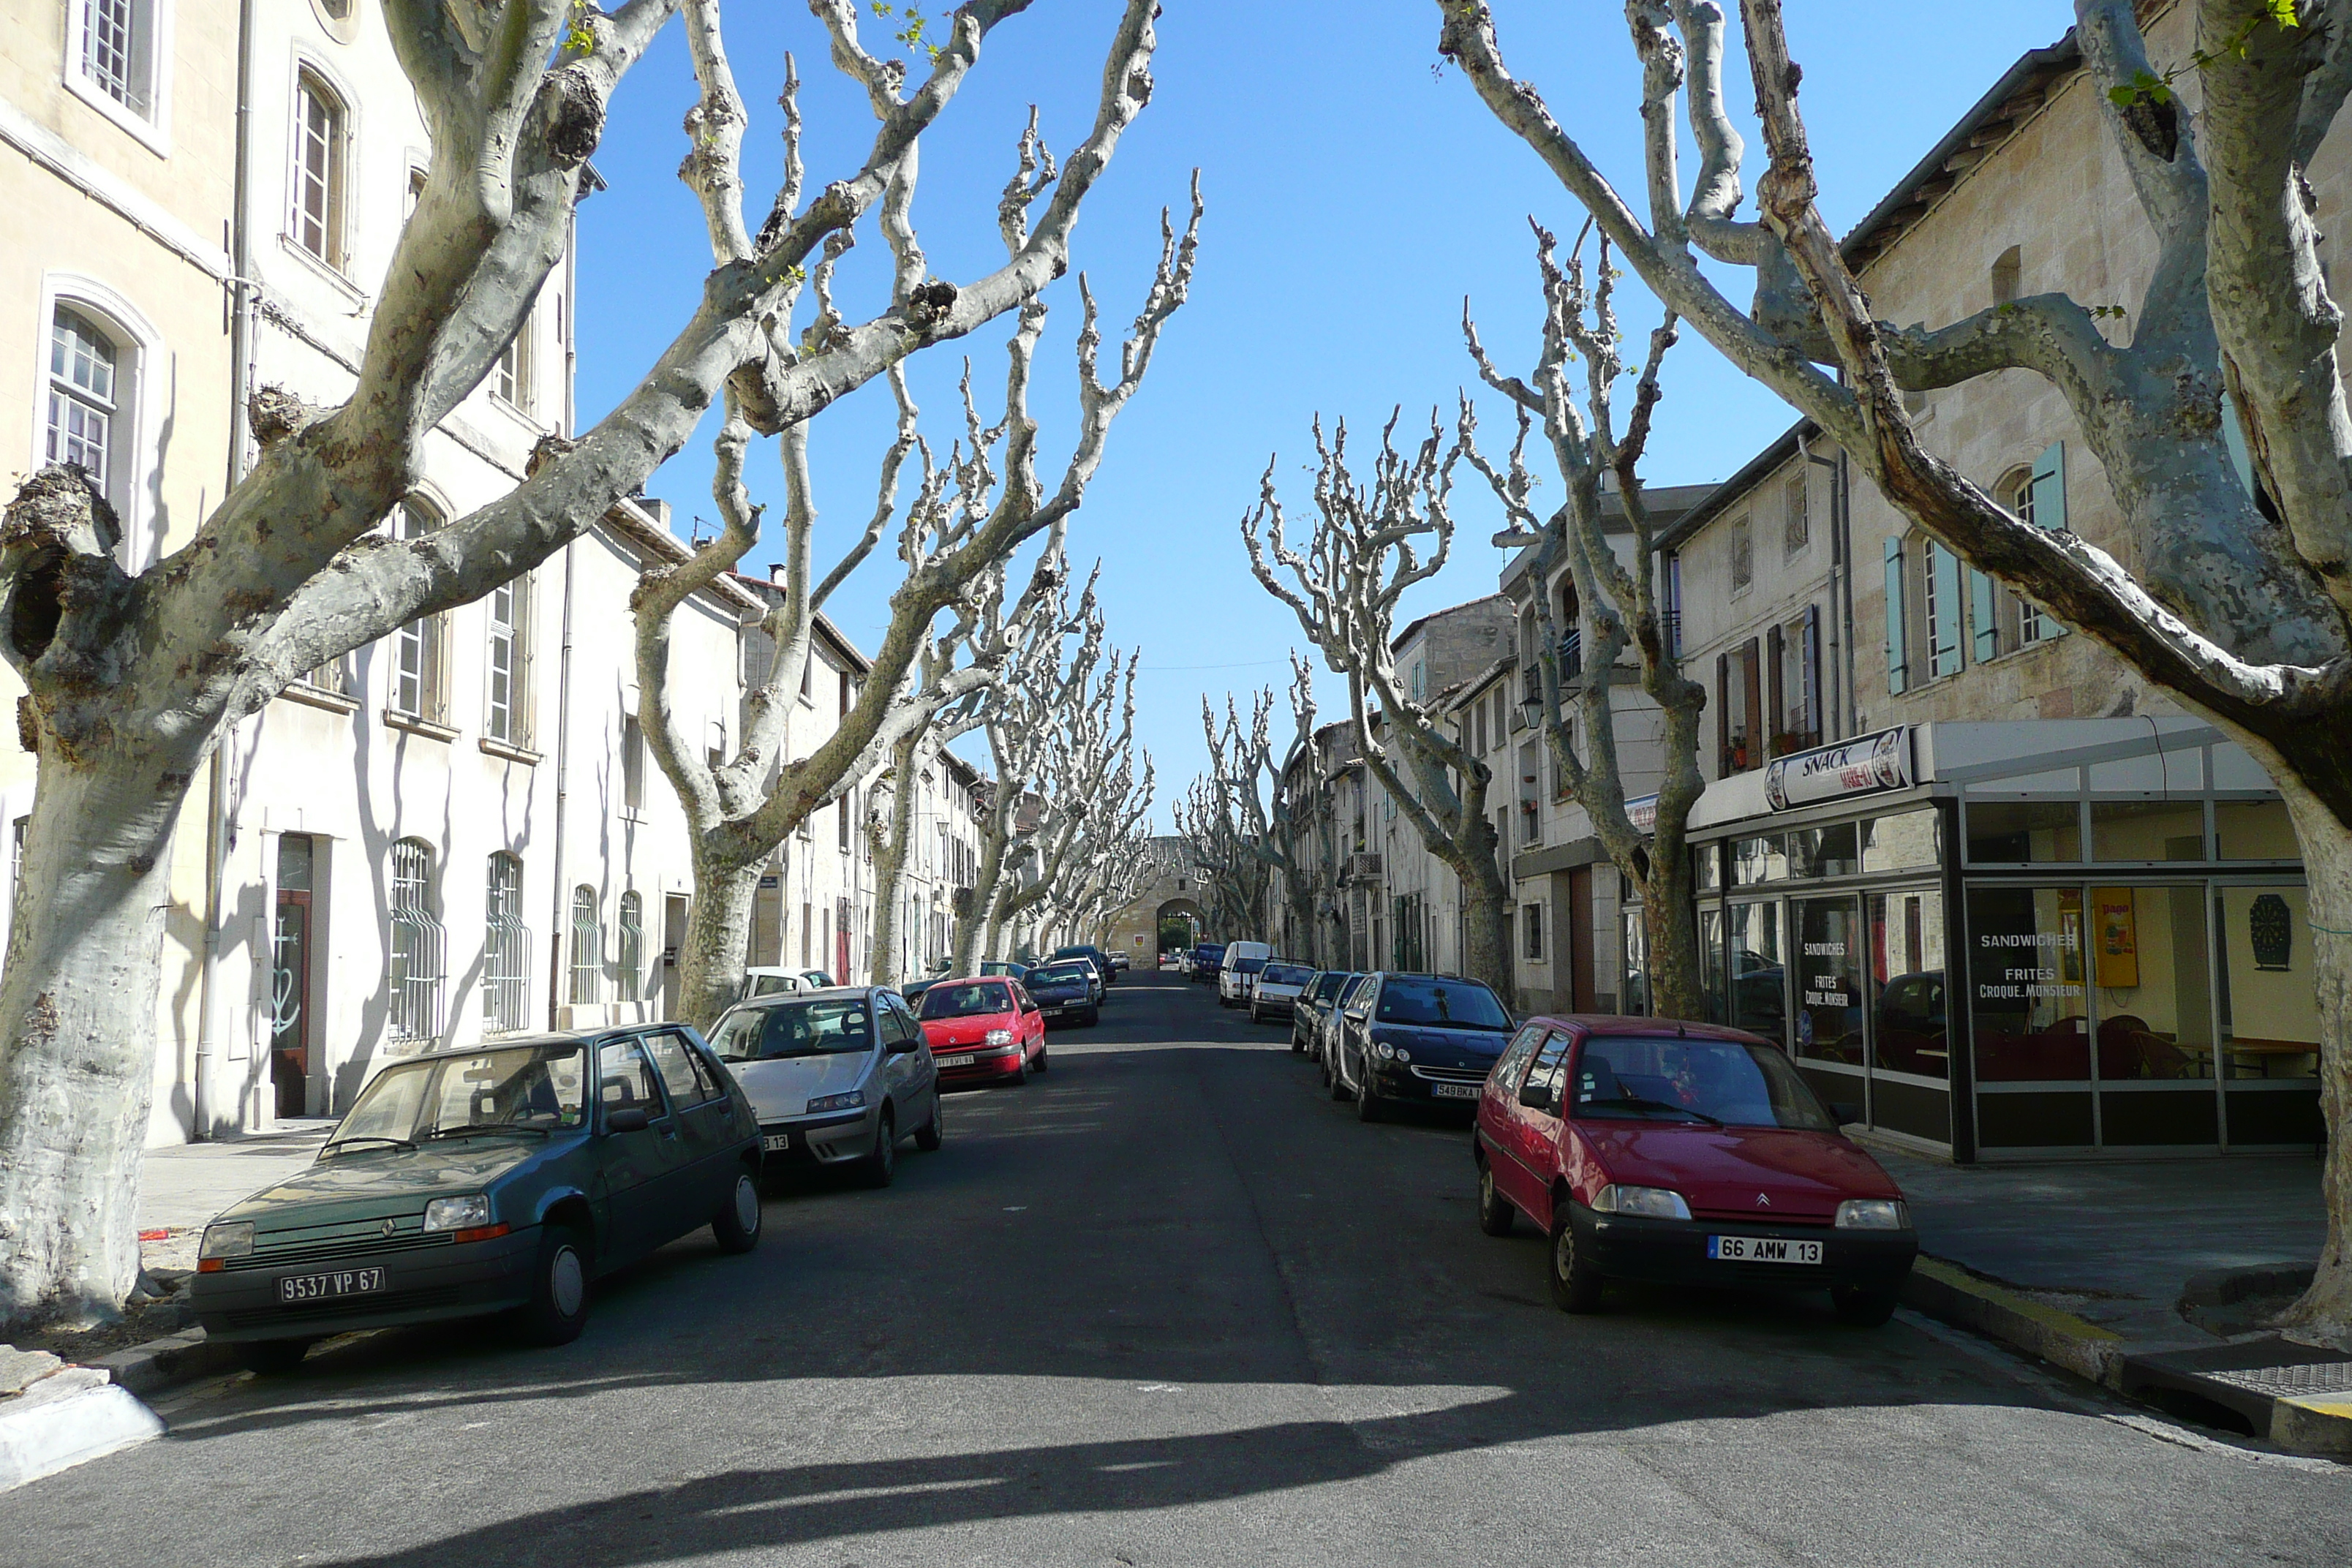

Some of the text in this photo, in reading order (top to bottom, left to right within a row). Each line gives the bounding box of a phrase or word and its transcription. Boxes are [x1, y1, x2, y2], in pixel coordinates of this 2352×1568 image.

[1802, 747, 1853, 777] SNACK
[1981, 934, 2075, 947] SANDWICHES
[1804, 942, 1844, 956] SANDWICHES
[2005, 968, 2055, 981] FRITES
[1815, 975, 1836, 989] FRITES
[774, 1136, 786, 1148] 13
[1722, 1239, 1744, 1256] 66
[1754, 1241, 1787, 1259] AMW
[1798, 1243, 1818, 1261] 13
[285, 1270, 379, 1299] 9537 VP 67
